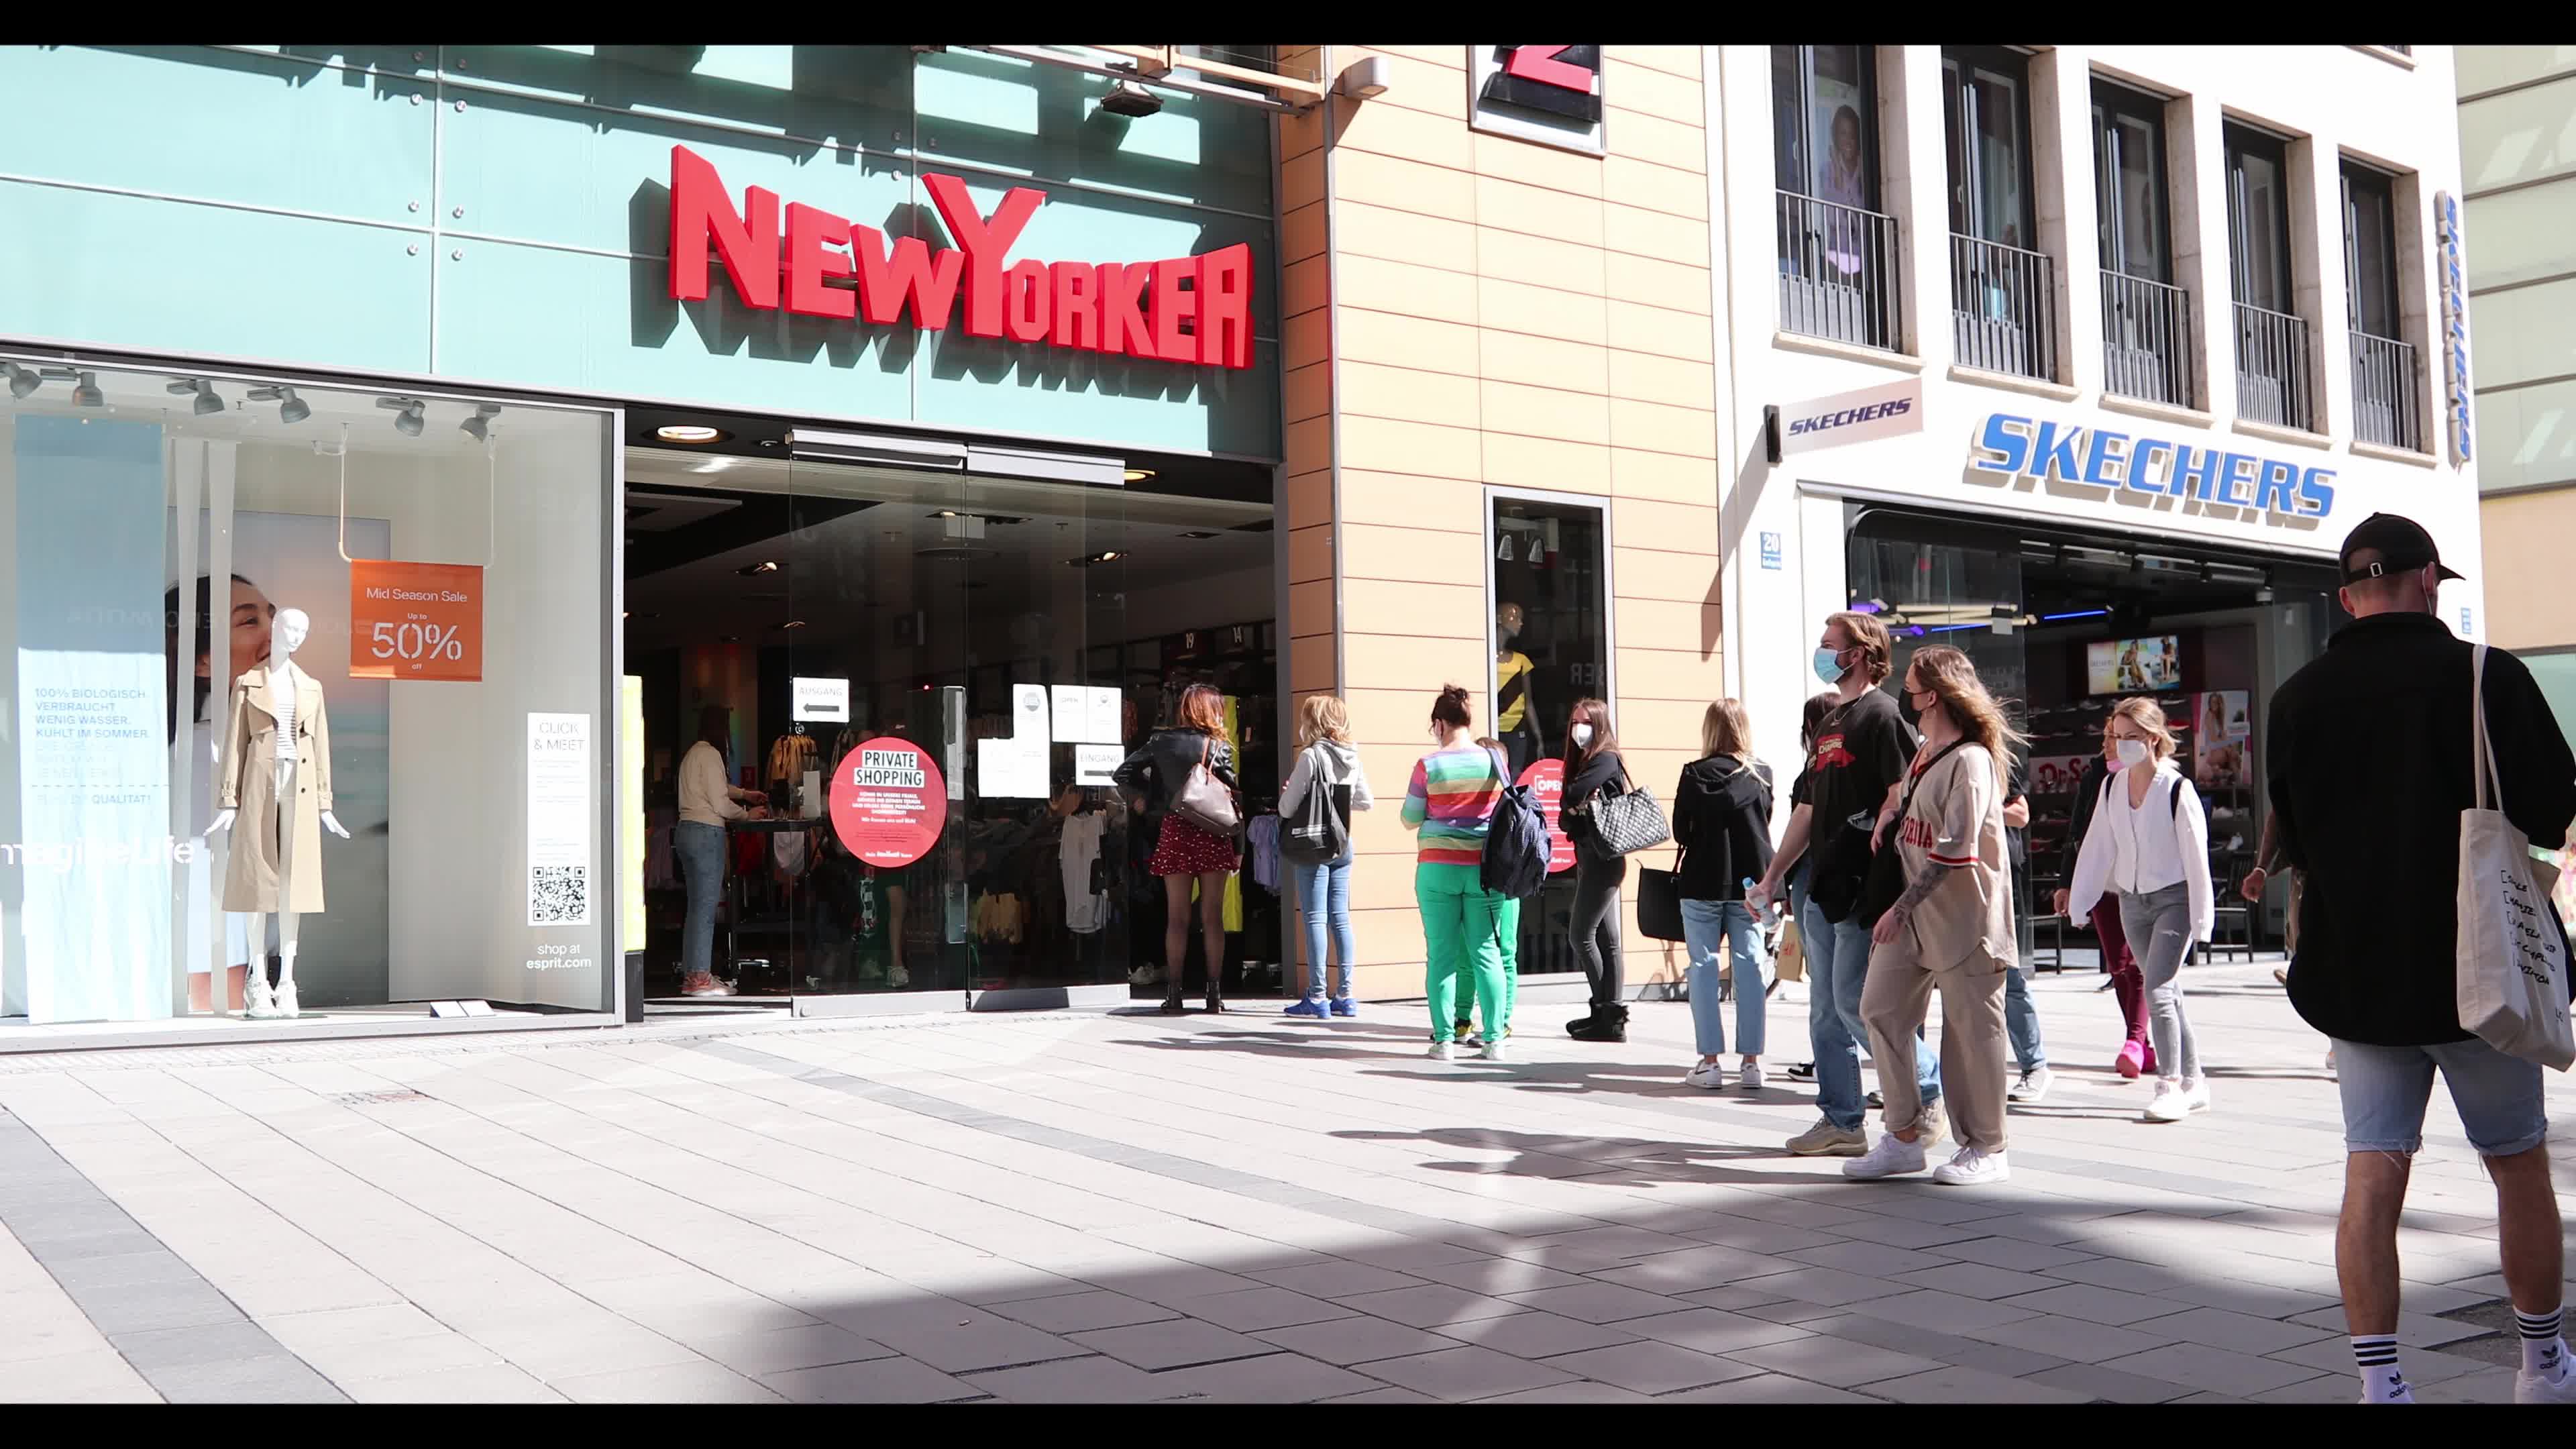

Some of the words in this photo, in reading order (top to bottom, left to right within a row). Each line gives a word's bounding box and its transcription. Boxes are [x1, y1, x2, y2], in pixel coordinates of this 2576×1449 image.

[1788, 396, 1912, 436] SKECHERS
[1977, 413, 2339, 518] SKECHERS
[1764, 533, 1779, 550] 20
[367, 588, 389, 599] Mid
[393, 588, 438, 601] Season
[441, 591, 468, 602] Sale
[372, 623, 462, 660] 50%
[1185, 633, 1195, 649] 19
[35, 688, 70, 698] 100%
[799, 686, 843, 697] AUSGANG
[36, 702, 116, 712] VERBRAUCHT
[36, 715, 75, 724] WENIG
[77, 729, 91, 739] IM
[539, 722, 580, 735] CLICK
[547, 739, 586, 751] MEET
[865, 752, 914, 767] PRIVATE
[1079, 752, 1120, 763] EINGANG
[856, 769, 922, 786] SHOPPING
[537, 945, 567, 956] shop
[570, 945, 580, 955] at
[526, 958, 592, 971] esprit.com
